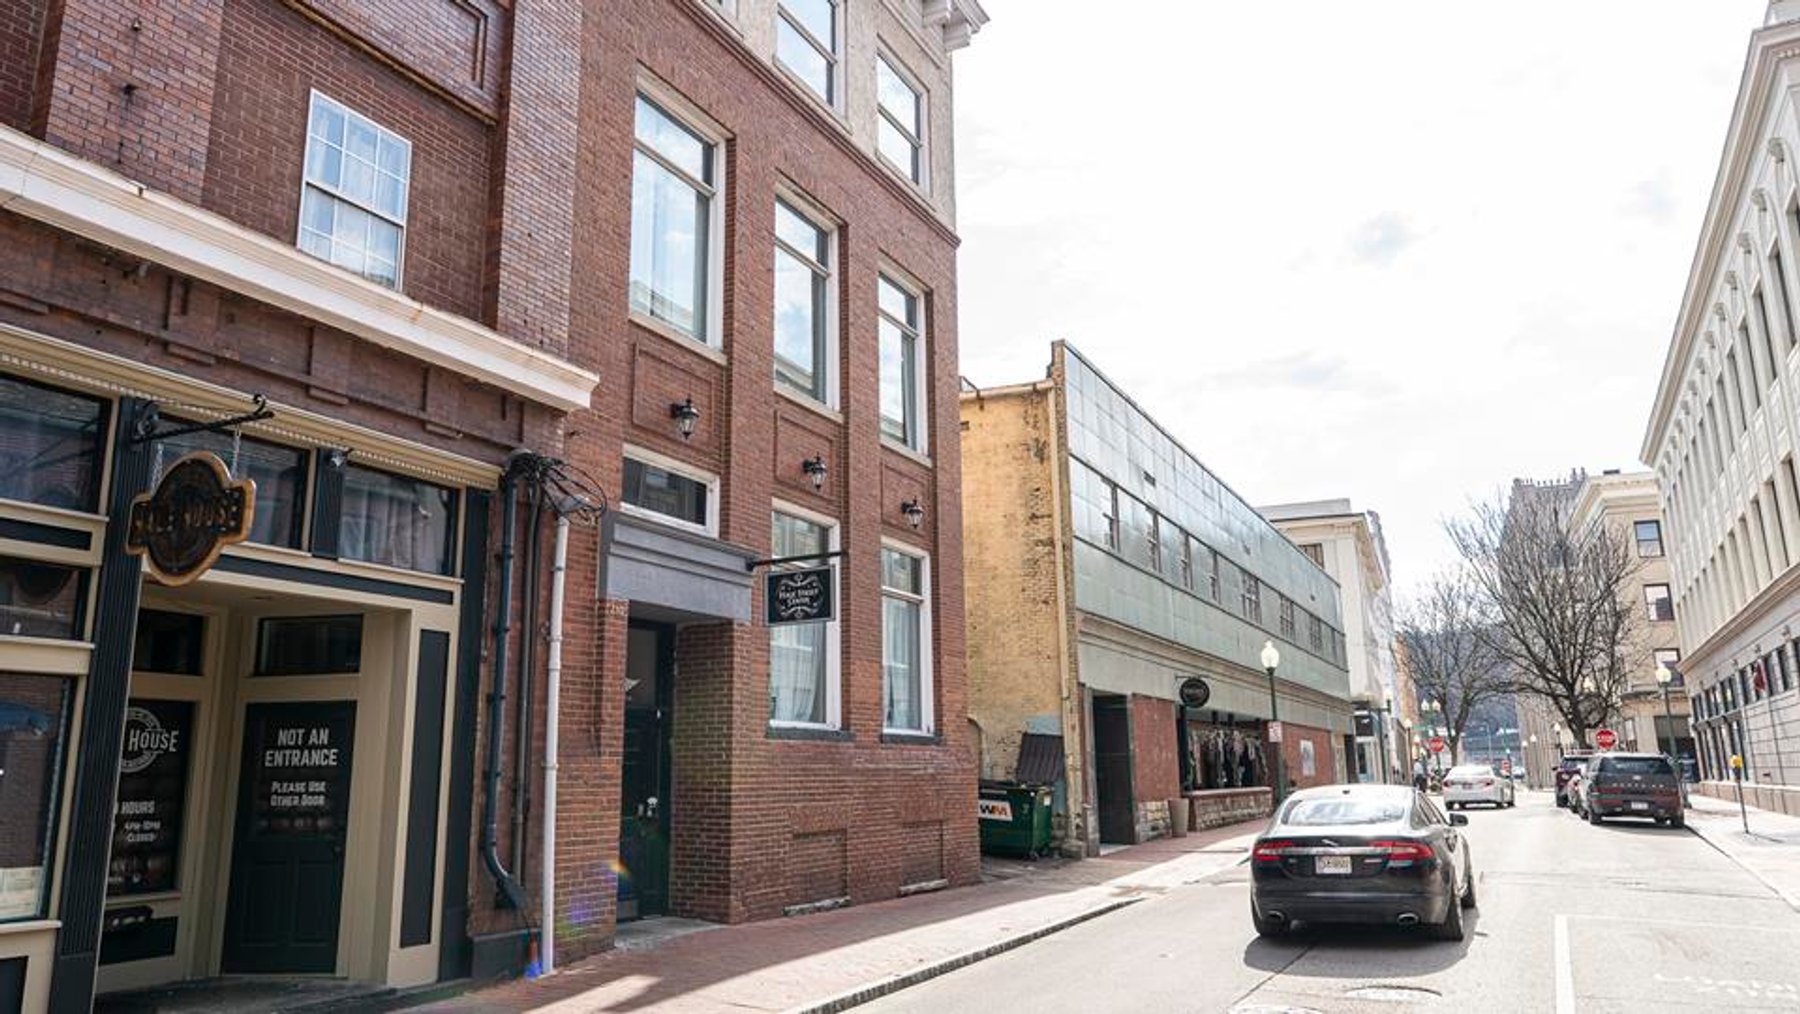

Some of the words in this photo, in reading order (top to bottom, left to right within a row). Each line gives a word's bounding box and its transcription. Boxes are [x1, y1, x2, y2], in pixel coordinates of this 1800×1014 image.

[128, 728, 180, 752] HOUSE
[278, 728, 305, 746] NOT
[308, 728, 329, 745] AN
[265, 749, 338, 767] ENTRANCE
[271, 781, 306, 793] PLEASE
[308, 781, 326, 792] USE
[121, 801, 155, 814] HOURS
[270, 795, 300, 806] OTHER
[301, 794, 325, 806] DOOR
